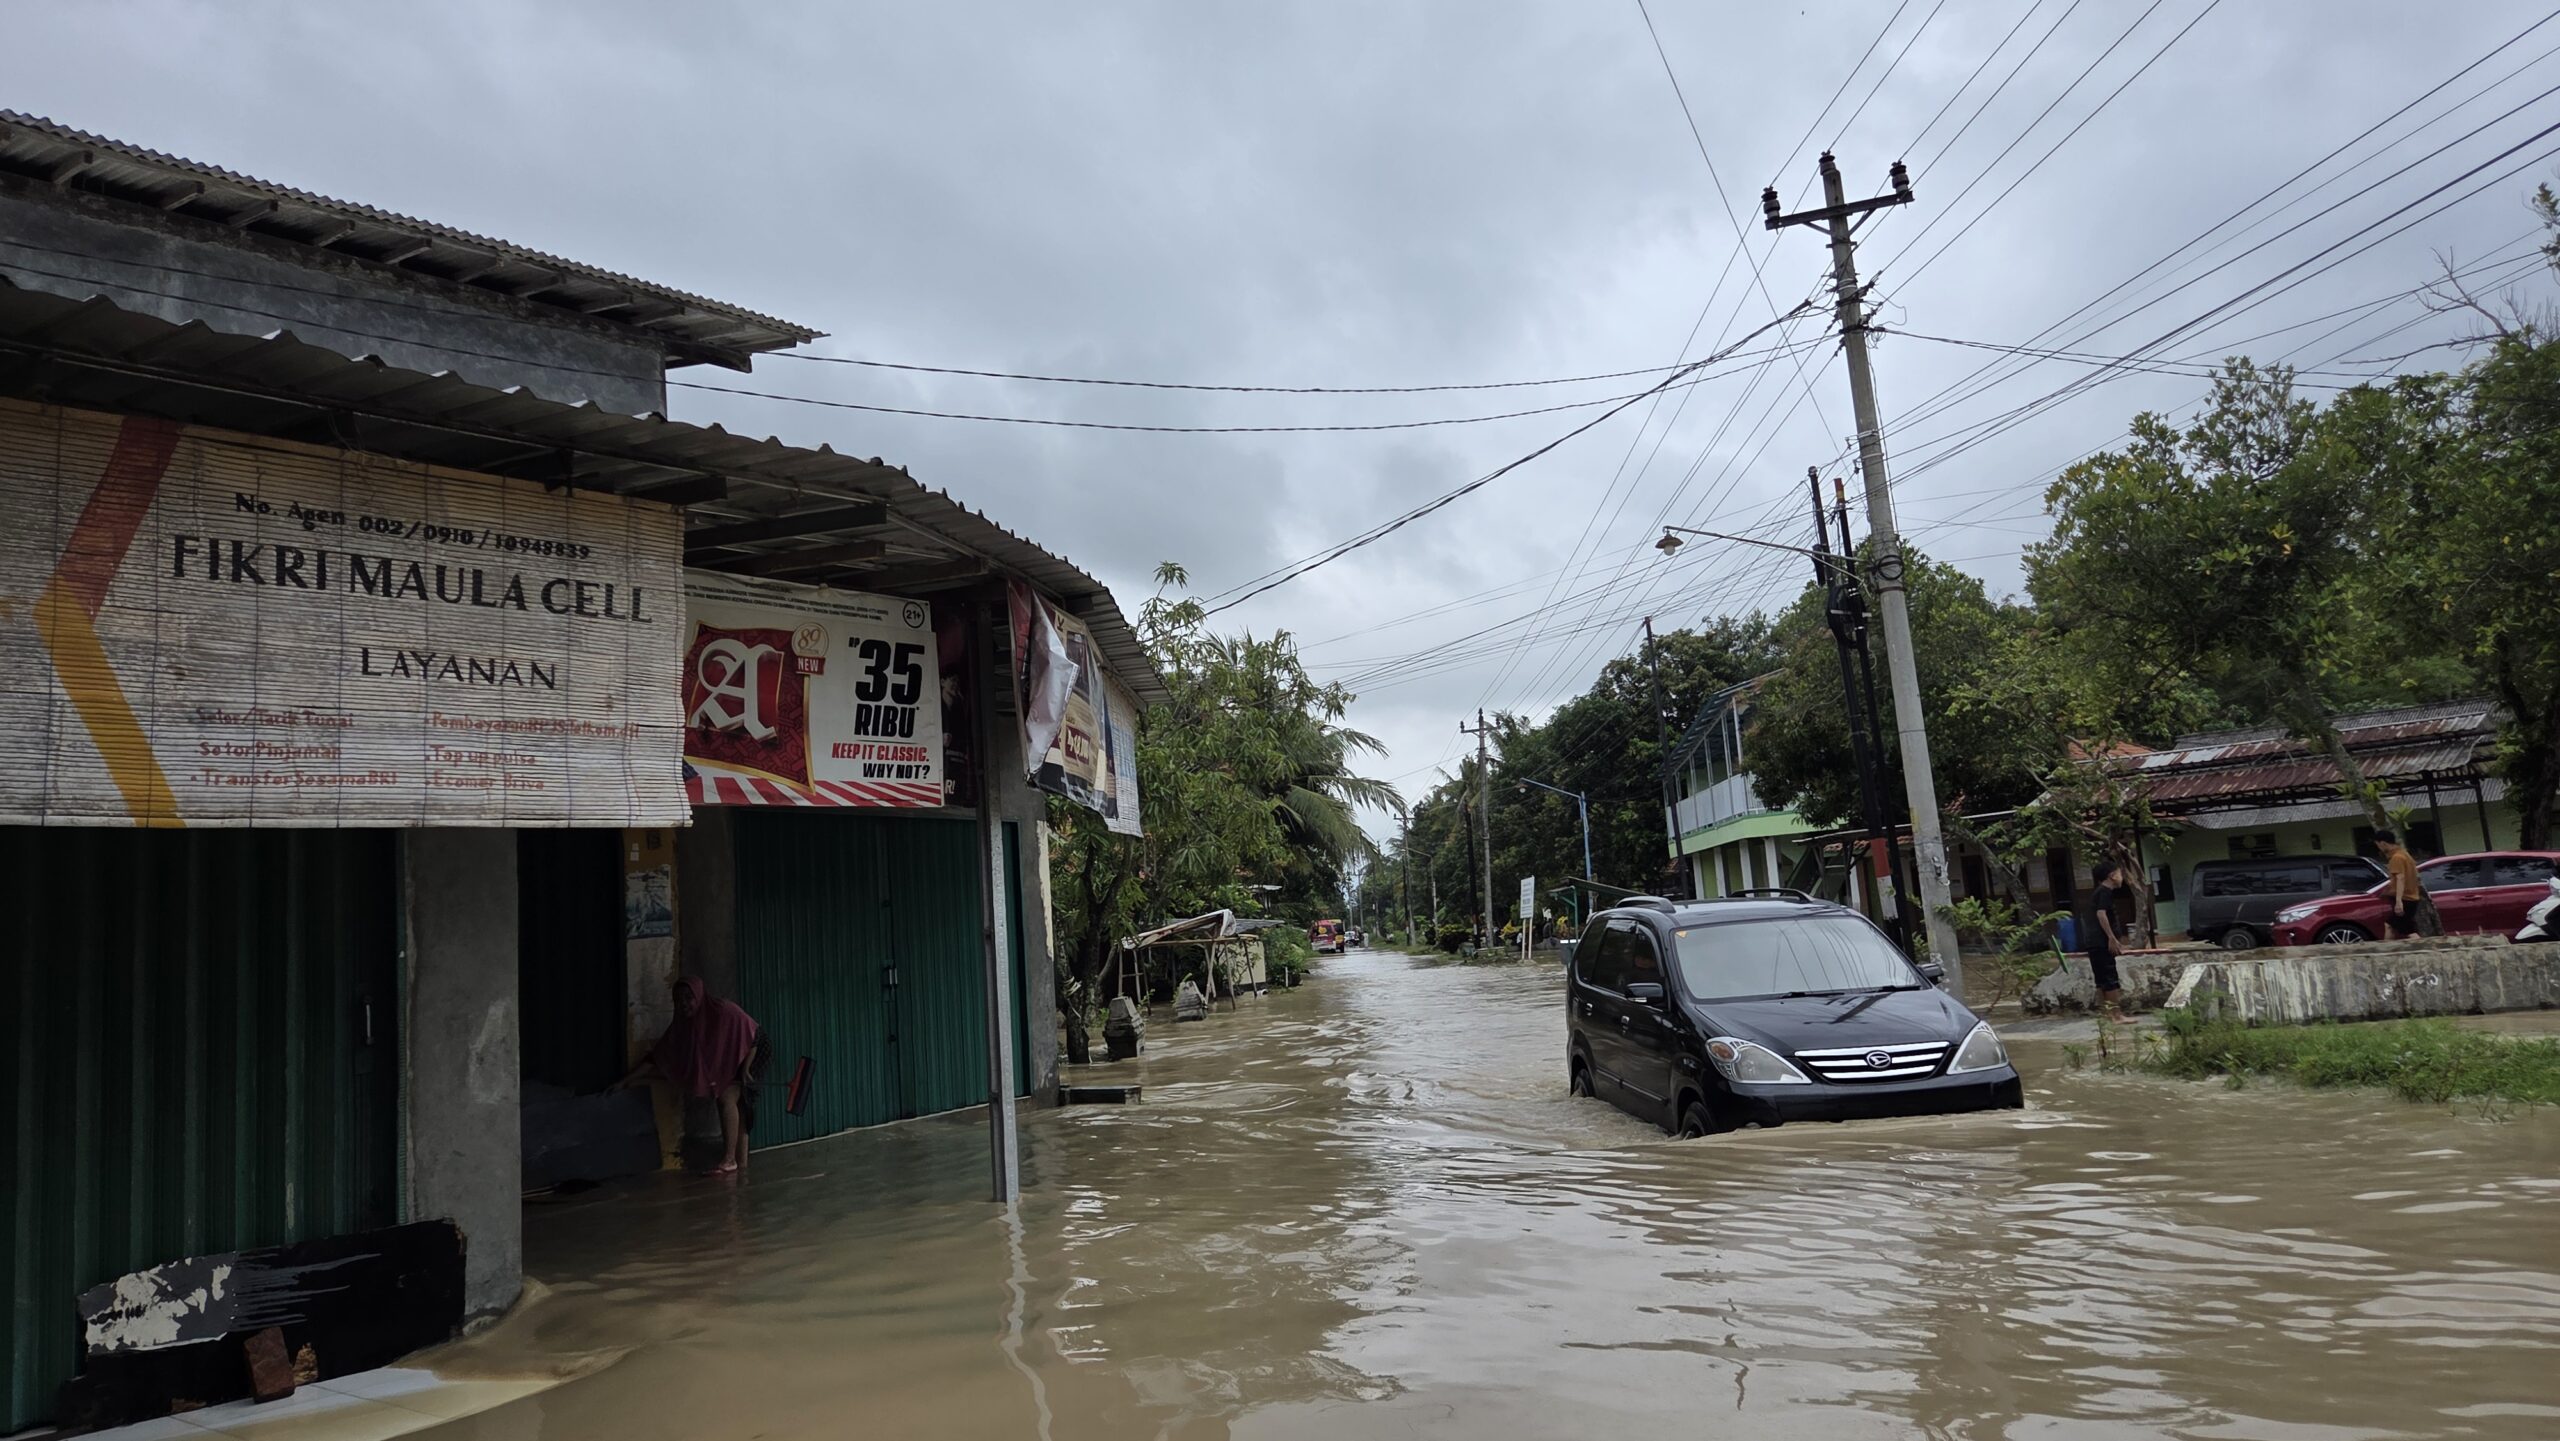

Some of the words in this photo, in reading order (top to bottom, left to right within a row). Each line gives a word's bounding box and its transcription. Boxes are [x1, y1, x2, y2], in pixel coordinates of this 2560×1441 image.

[236, 492, 278, 515] No.
[288, 501, 345, 531] Agen
[174, 535, 327, 590] FIKRI
[351, 554, 529, 611] MAULA
[540, 578, 653, 623] CELL
[906, 609, 922, 621] 21+
[798, 628, 821, 649] 89
[361, 648, 556, 690] LAYANAN
[797, 657, 819, 672] NEW
[855, 639, 925, 705] 35
[430, 744, 462, 767] Top
[468, 750, 489, 769] up
[832, 743, 861, 759] KEEP
[862, 744, 875, 760] IT
[876, 745, 930, 762] CLASSIC.
[863, 763, 894, 778] WHY
[896, 764, 931, 779] NOT?
